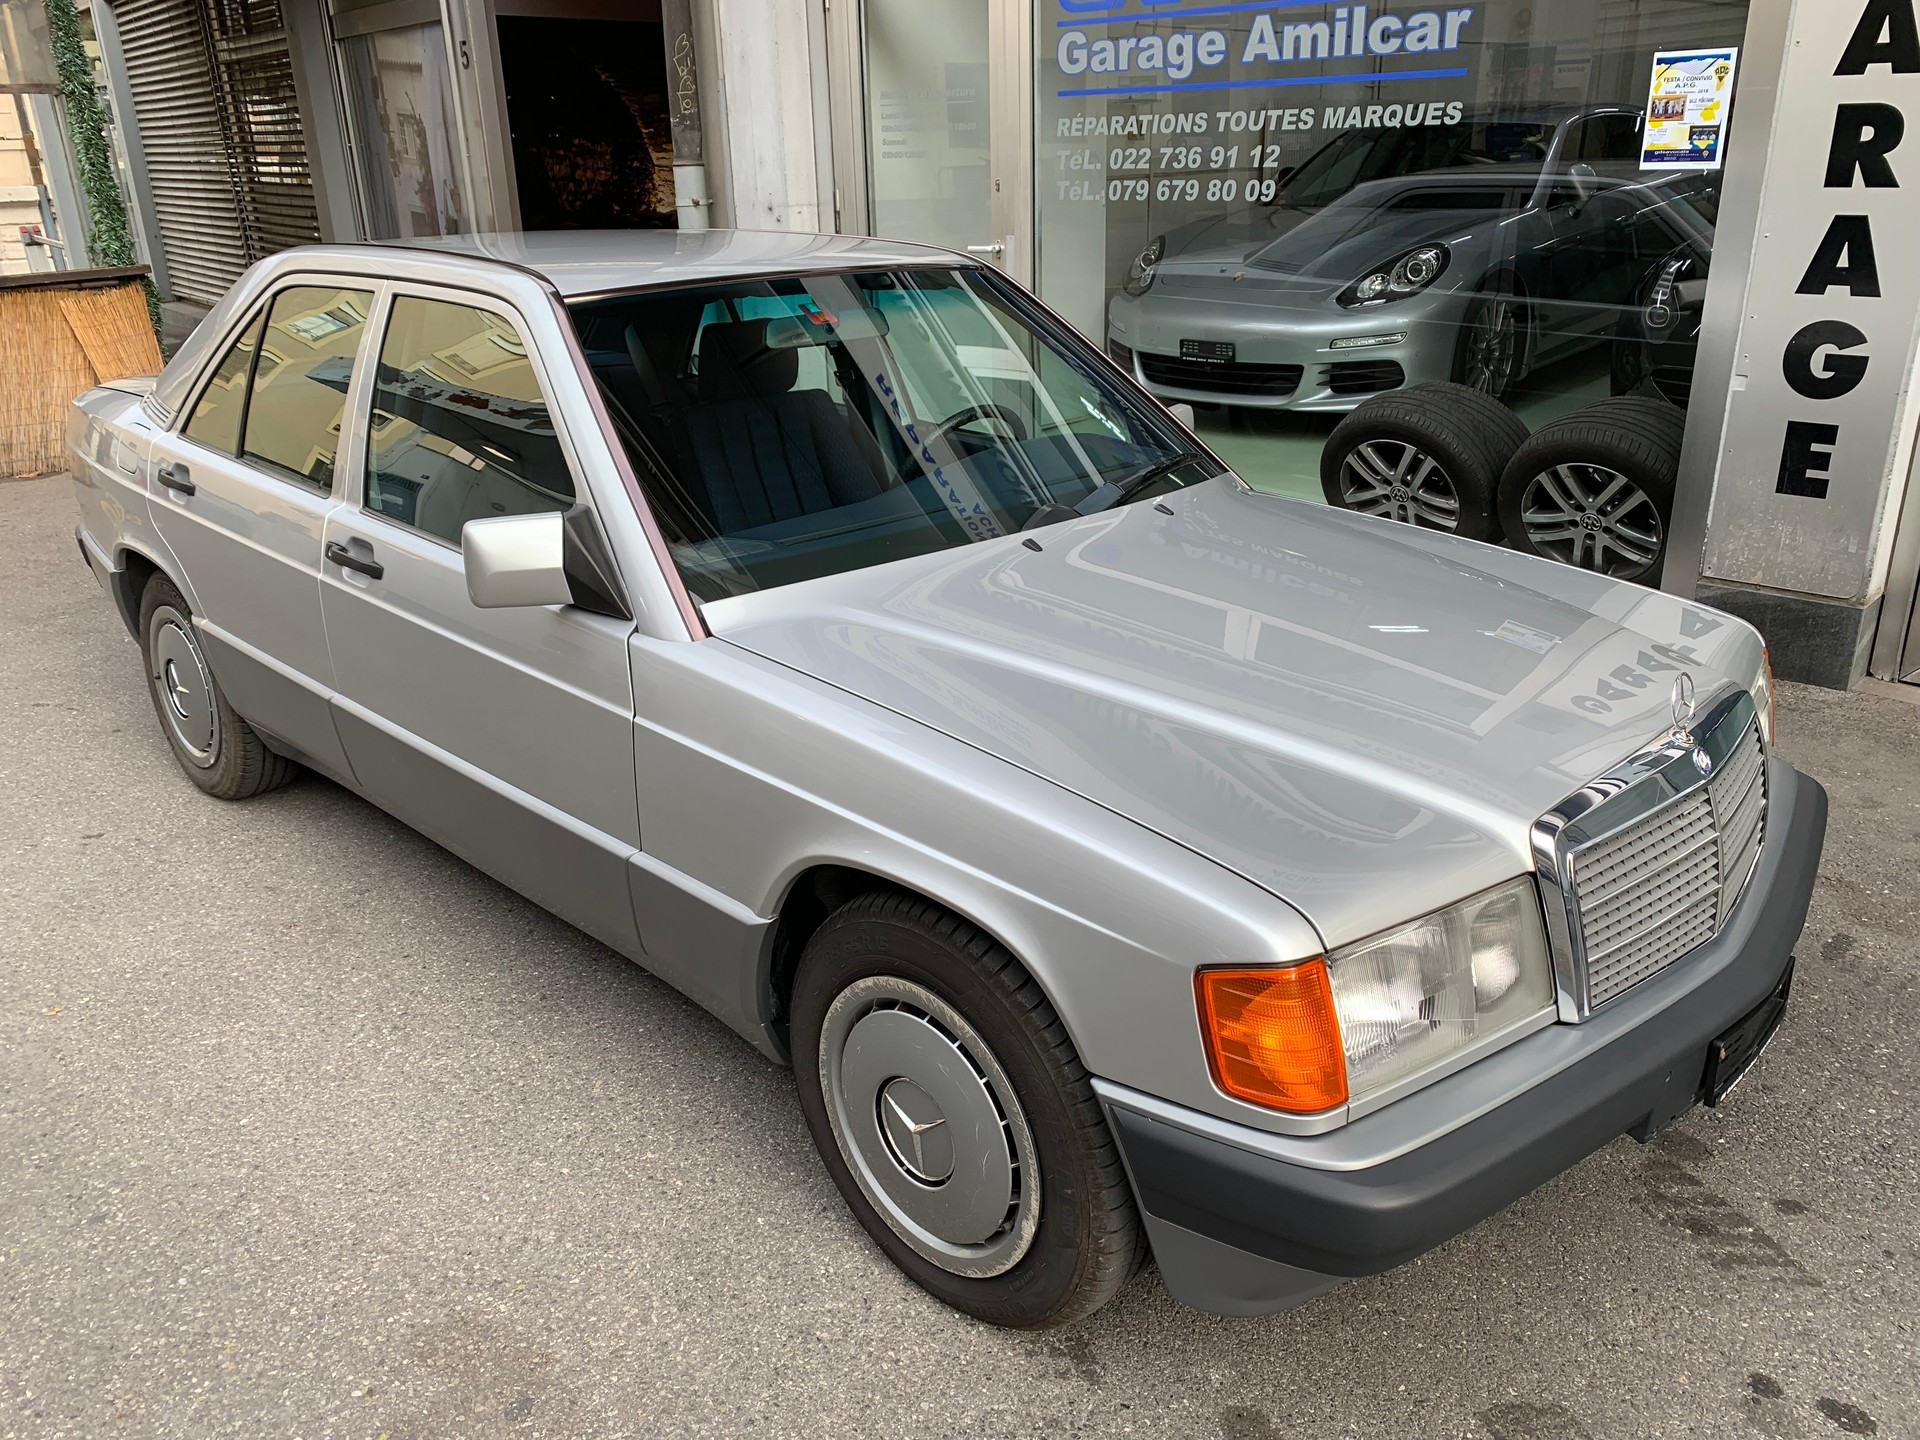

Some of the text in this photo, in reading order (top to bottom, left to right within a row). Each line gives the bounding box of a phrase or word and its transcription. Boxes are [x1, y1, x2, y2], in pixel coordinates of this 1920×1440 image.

[1057, 4, 1474, 80] Garage Amilcar
[1057, 101, 1464, 137] RÉPARATIONS TOUTES MARQUES
[1109, 148, 1151, 169] 022
[1159, 146, 1202, 169] 736
[1209, 145, 1238, 168] 91
[1249, 145, 1281, 168] 12
[1108, 180, 1150, 201] 079
[1157, 179, 1199, 201] 679
[1207, 179, 1237, 201] 80
[1244, 178, 1276, 202] 09
